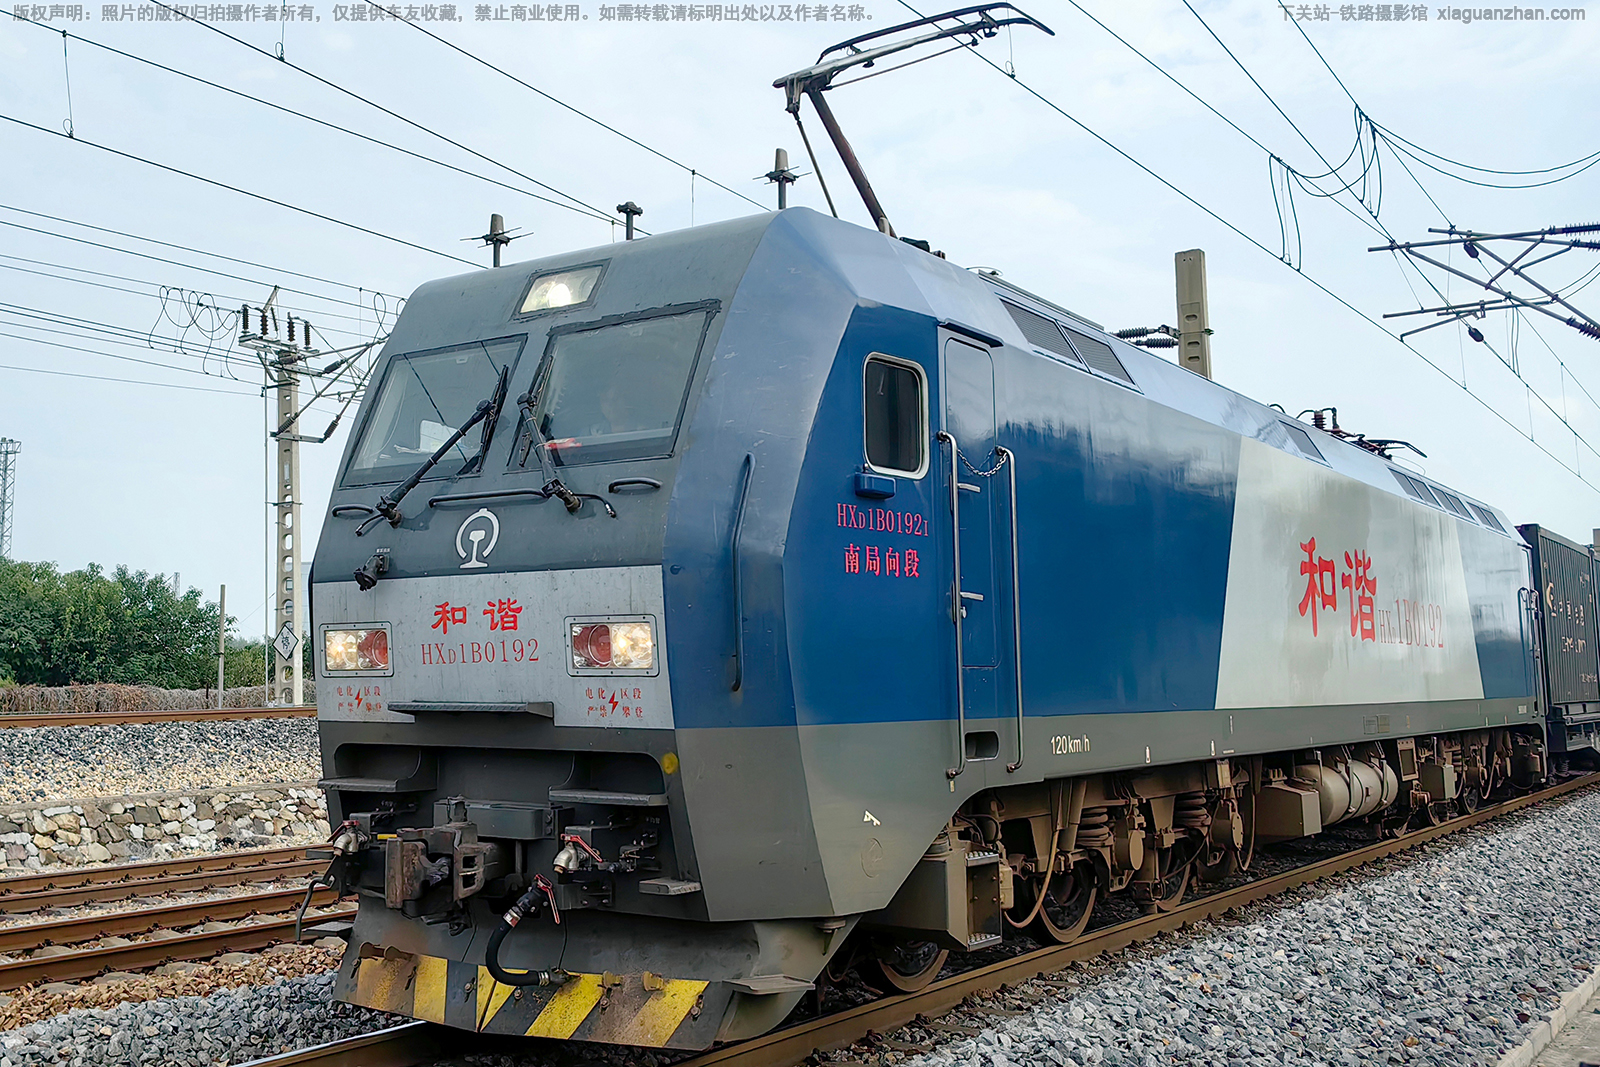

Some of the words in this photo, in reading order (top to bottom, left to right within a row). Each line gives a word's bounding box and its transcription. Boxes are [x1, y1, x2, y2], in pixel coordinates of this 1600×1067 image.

[843, 543, 920, 578] 南局向段
[1299, 536, 1377, 642] 和谐
[431, 597, 523, 635] 和谐
[421, 638, 540, 665] HXD1B0192
